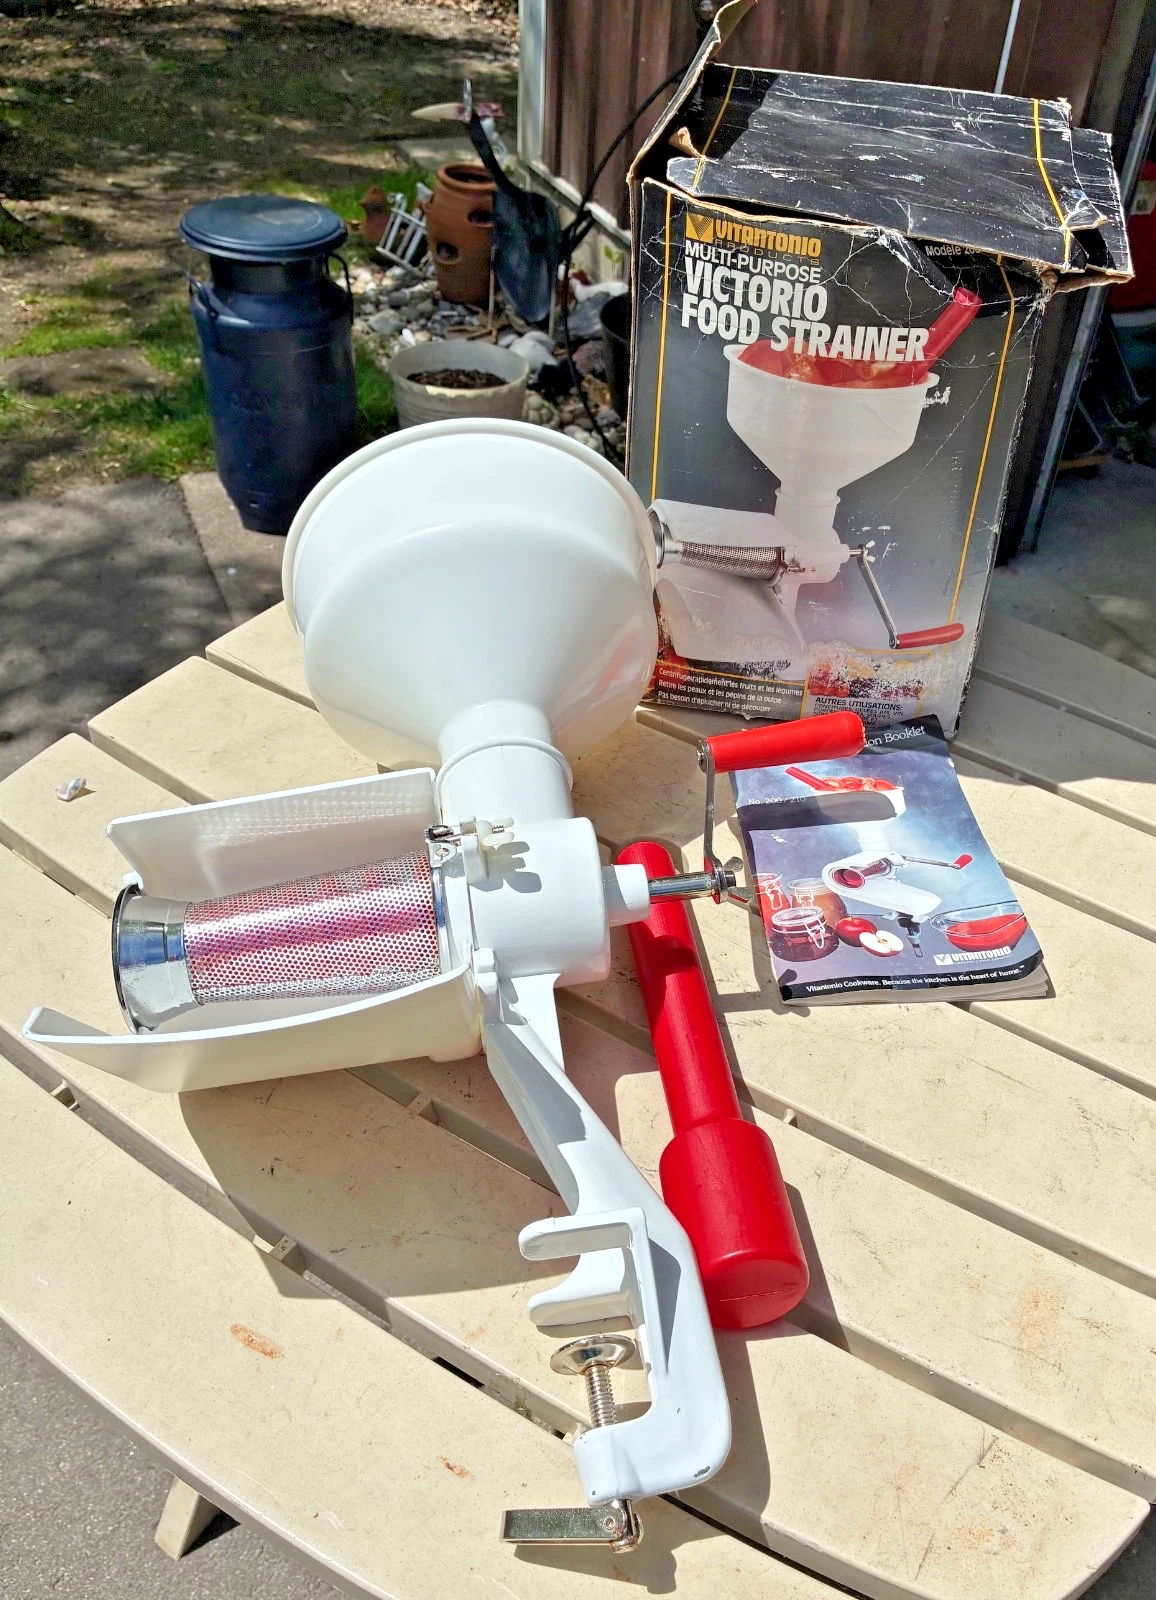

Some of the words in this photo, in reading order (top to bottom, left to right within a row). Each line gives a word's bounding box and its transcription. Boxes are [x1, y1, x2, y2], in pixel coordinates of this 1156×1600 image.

[715, 219, 822, 257] VITANTONIO
[714, 238, 820, 266] PRODUCTS
[925, 244, 961, 256] Modèle
[685, 240, 822, 284] MULTI-PURPOSE
[684, 256, 828, 321] VICTORIO
[681, 293, 760, 344] FOOD
[658, 679, 677, 690] Retire
[678, 683, 687, 691] les
[688, 685, 707, 695] peaux
[708, 688, 715, 696] et
[716, 689, 724, 698] les
[747, 693, 755, 701] de
[757, 694, 762, 702] la
[658, 690, 669, 699] Pas
[670, 692, 690, 703] besoin
[740, 682, 756, 691] fruits
[766, 685, 774, 693] les
[776, 686, 803, 697] légumes
[815, 696, 847, 706] AUTRES
[848, 700, 903, 711] UTILISATIONS:
[863, 736, 882, 748] ion
[884, 725, 926, 743] Booklet
[951, 945, 1012, 961] VITANTONIO
[806, 983, 843, 992] Vitantonio
[844, 979, 881, 987] Cookware.
[925, 975, 950, 983] kitchen
[958, 974, 970, 982] the
